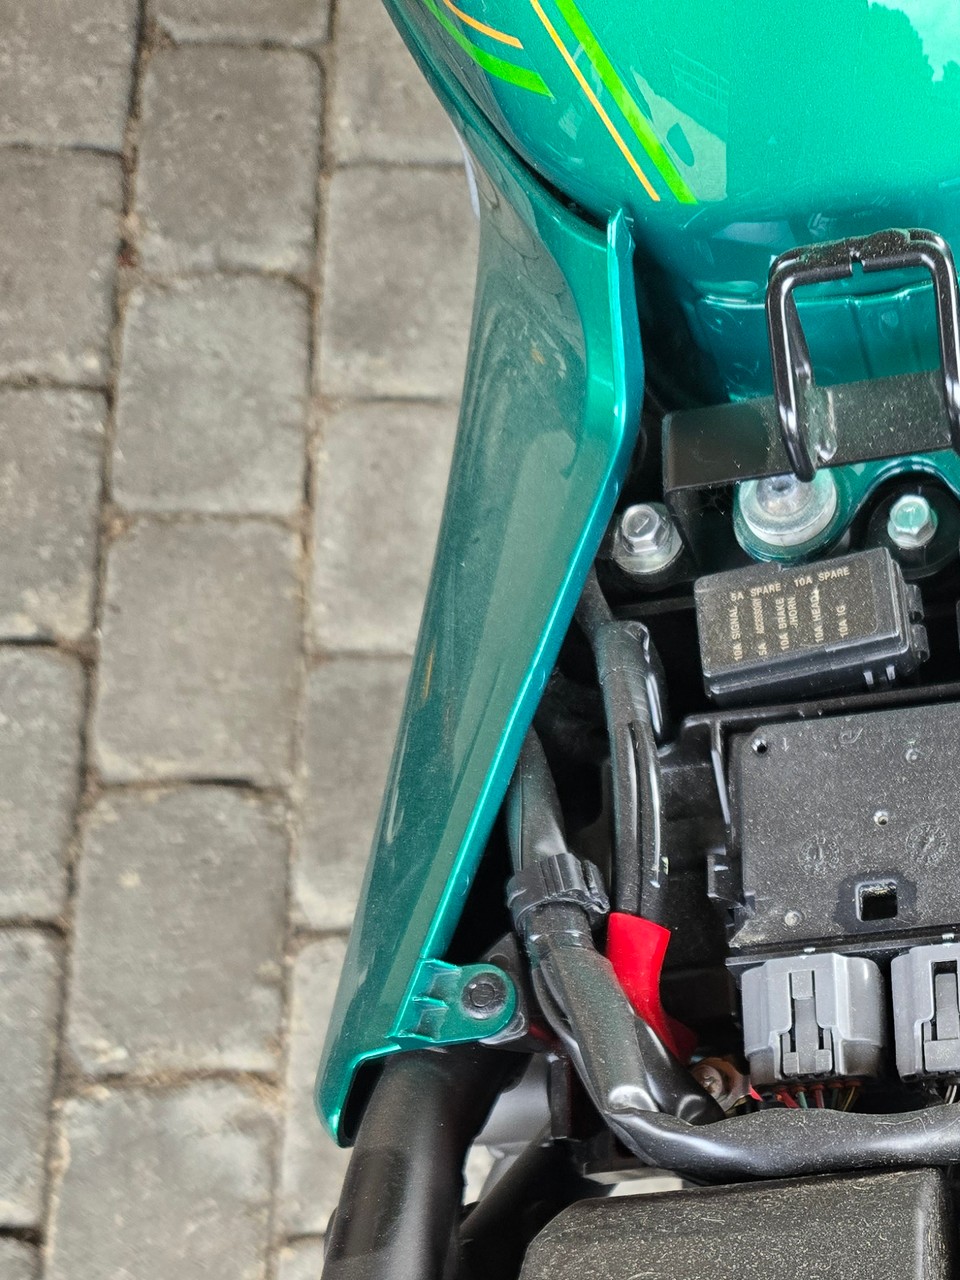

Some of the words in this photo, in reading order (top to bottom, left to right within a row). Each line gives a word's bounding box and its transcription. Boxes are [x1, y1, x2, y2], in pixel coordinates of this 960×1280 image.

[794, 576, 813, 587] 10A
[818, 566, 850, 581] SPARE
[730, 592, 744, 602] 5A
[750, 582, 781, 597] SPARE
[775, 597, 787, 630] BRAKE
[836, 604, 846, 616] IG
[729, 605, 741, 640] SIGNAL
[838, 619, 848, 638] 10A
[779, 632, 789, 651] 10A
[815, 625, 824, 643] 10A
[733, 643, 743, 661] 10A
[758, 642, 767, 656] 5A
